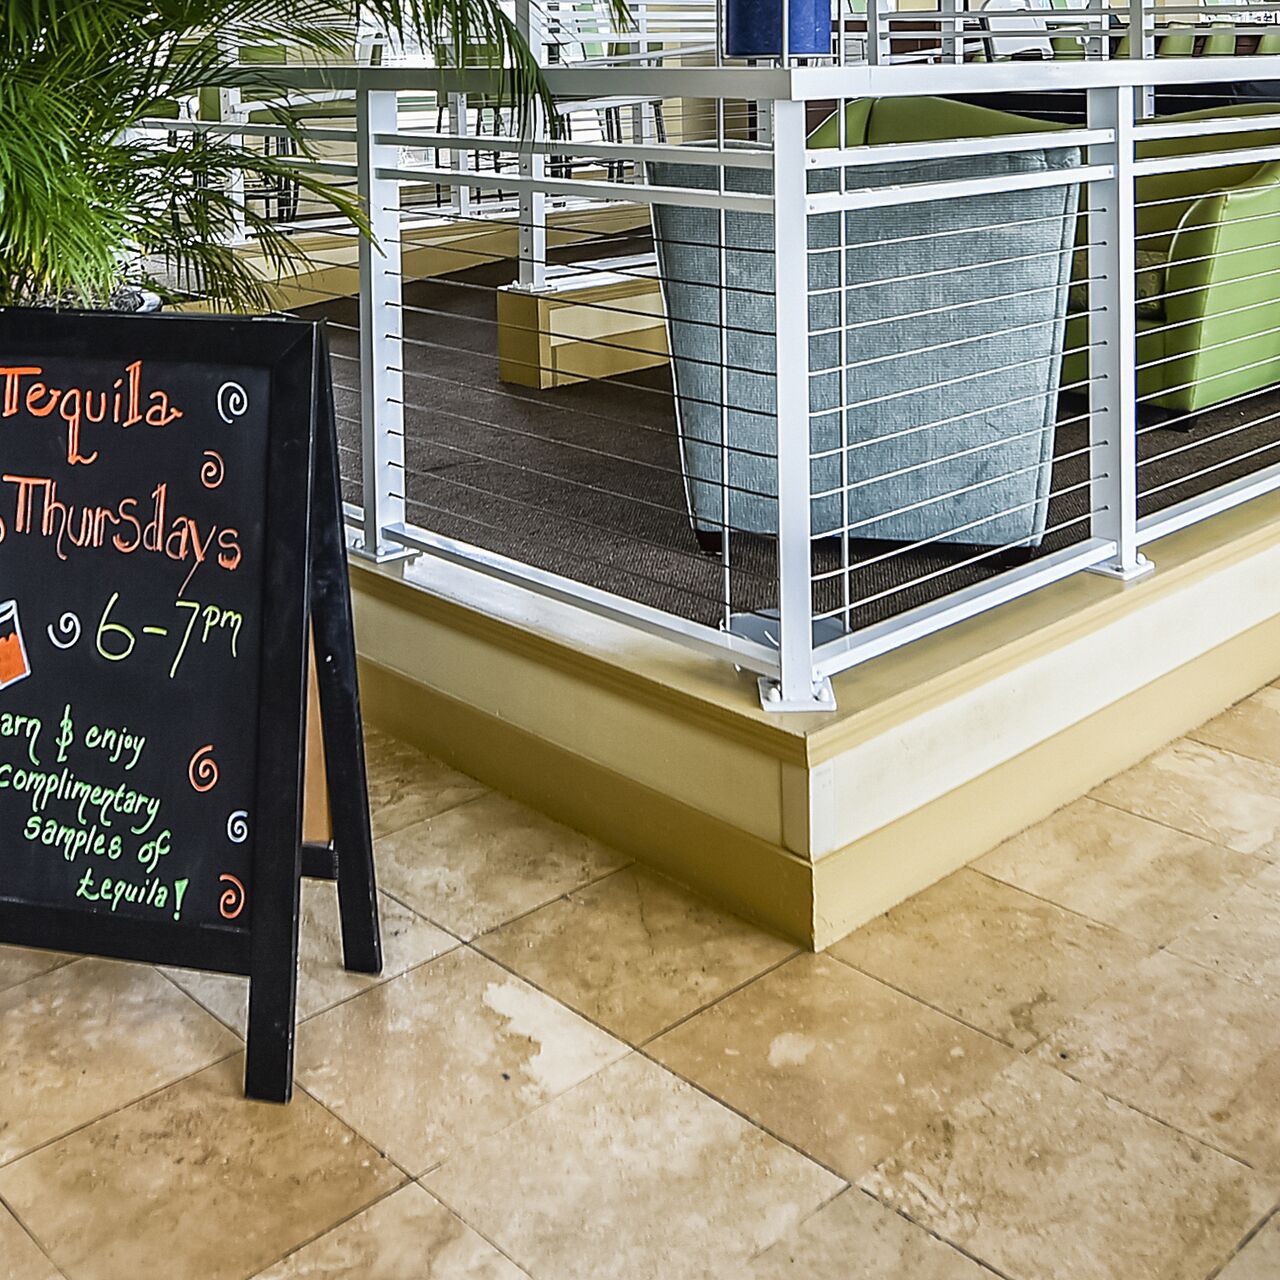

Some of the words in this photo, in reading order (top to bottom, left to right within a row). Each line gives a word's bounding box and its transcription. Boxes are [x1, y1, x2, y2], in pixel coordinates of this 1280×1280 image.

[2, 474, 243, 597] Thursdays
[85, 725, 147, 770] enjoy
[23, 815, 122, 861] samples
[138, 830, 172, 873] of
